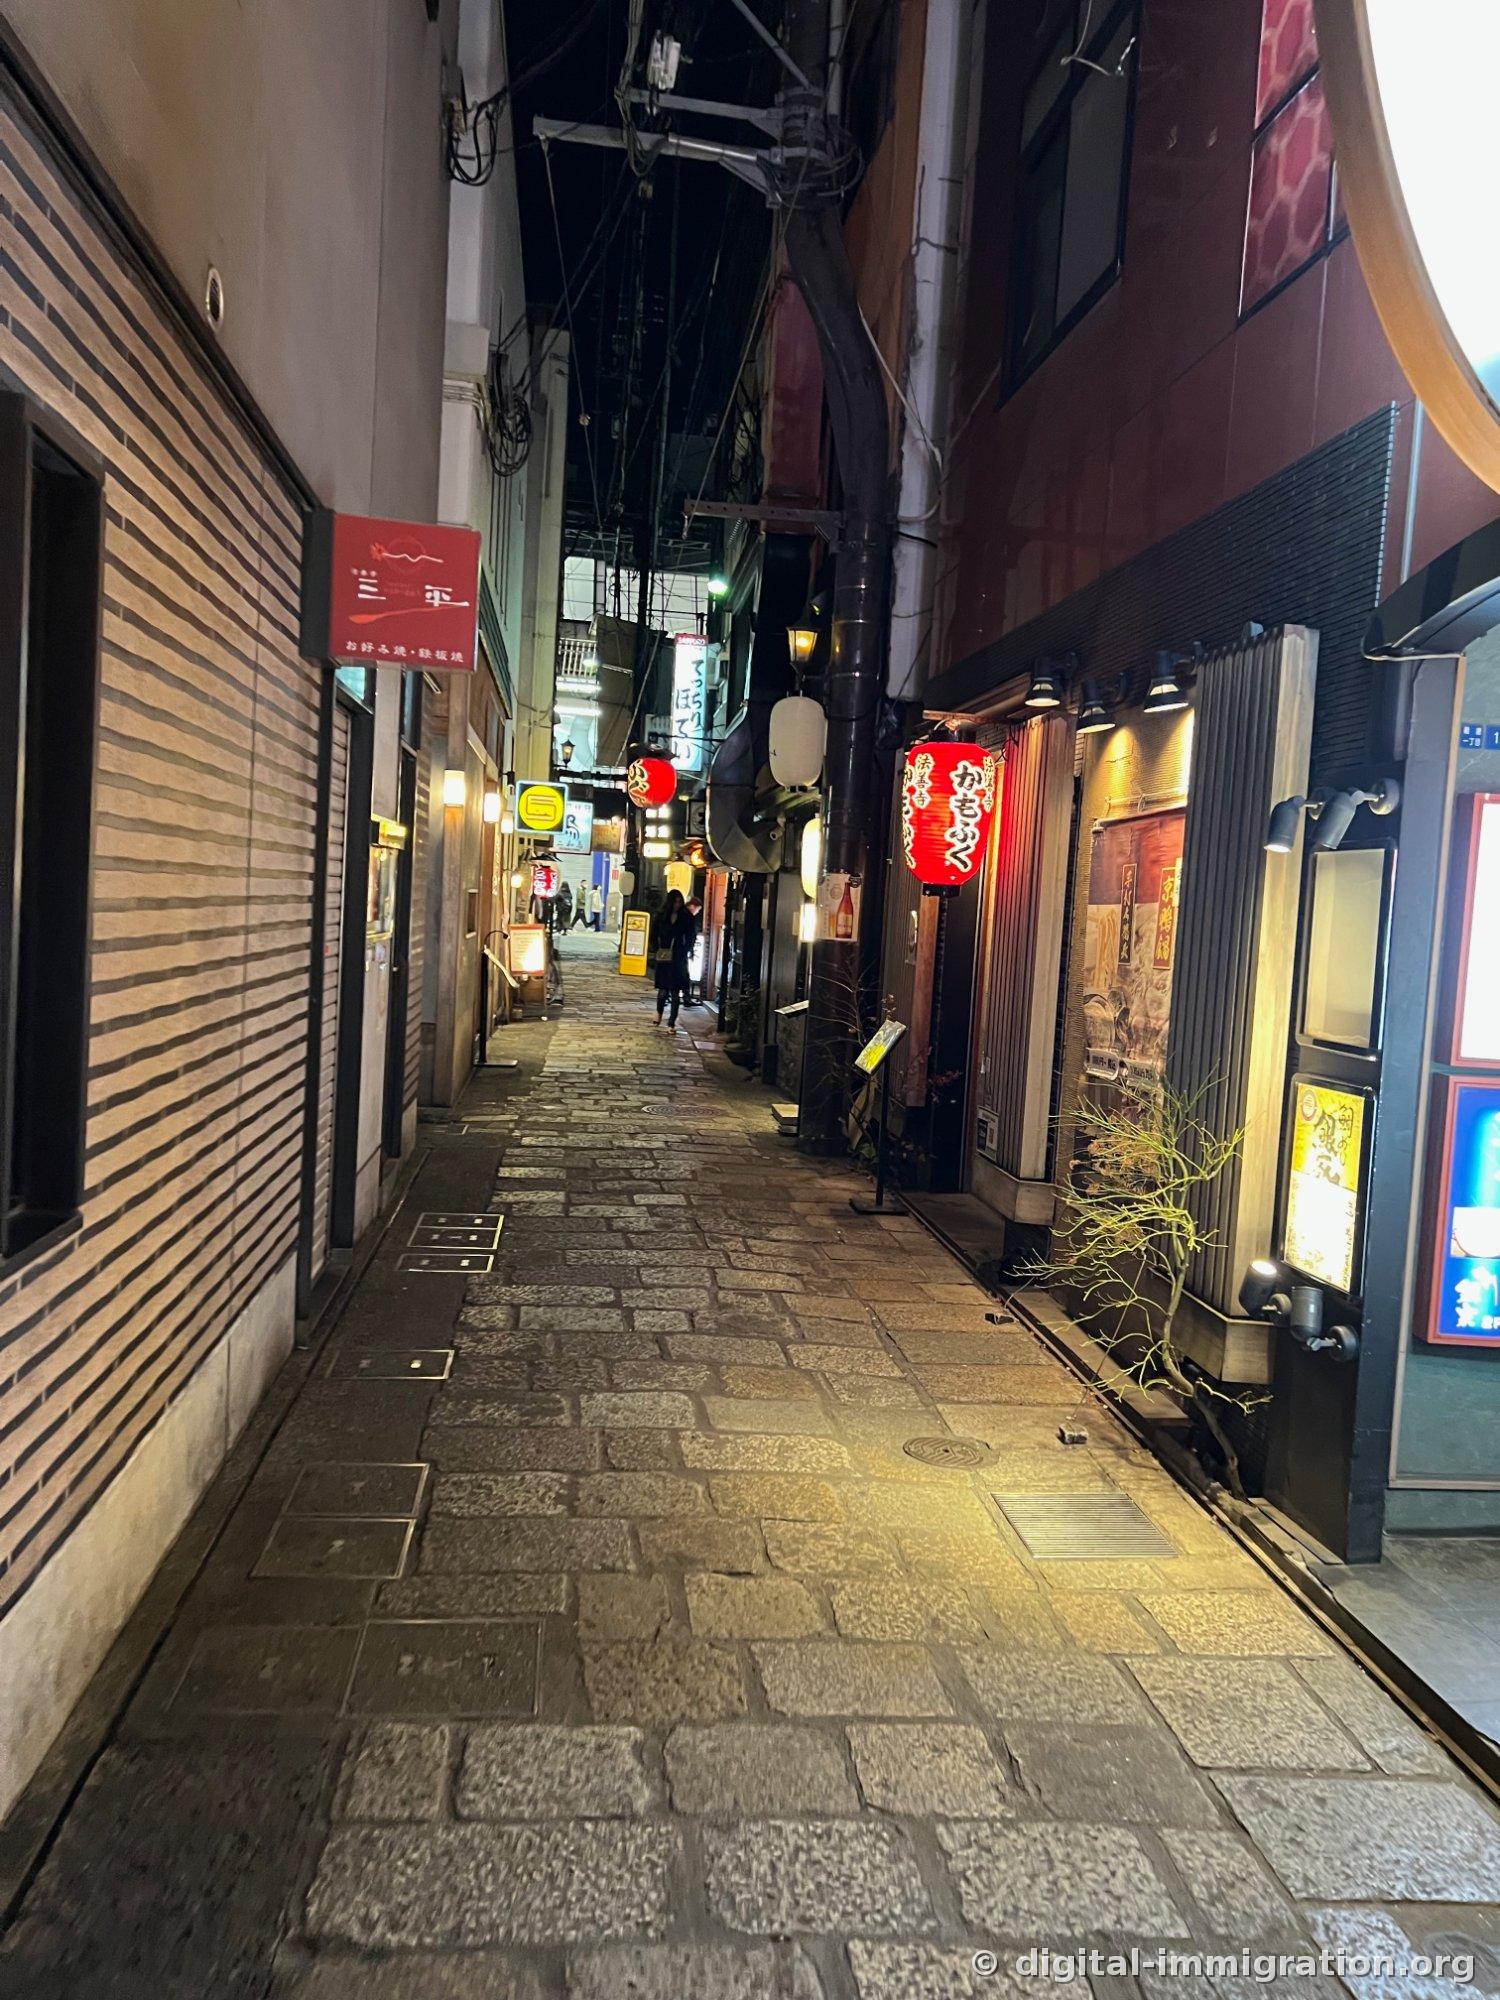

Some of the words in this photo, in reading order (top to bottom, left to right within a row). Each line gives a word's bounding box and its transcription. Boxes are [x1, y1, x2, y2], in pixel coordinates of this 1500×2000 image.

[916, 755, 933, 807] 法善寺
[949, 764, 983, 869] かもふく
